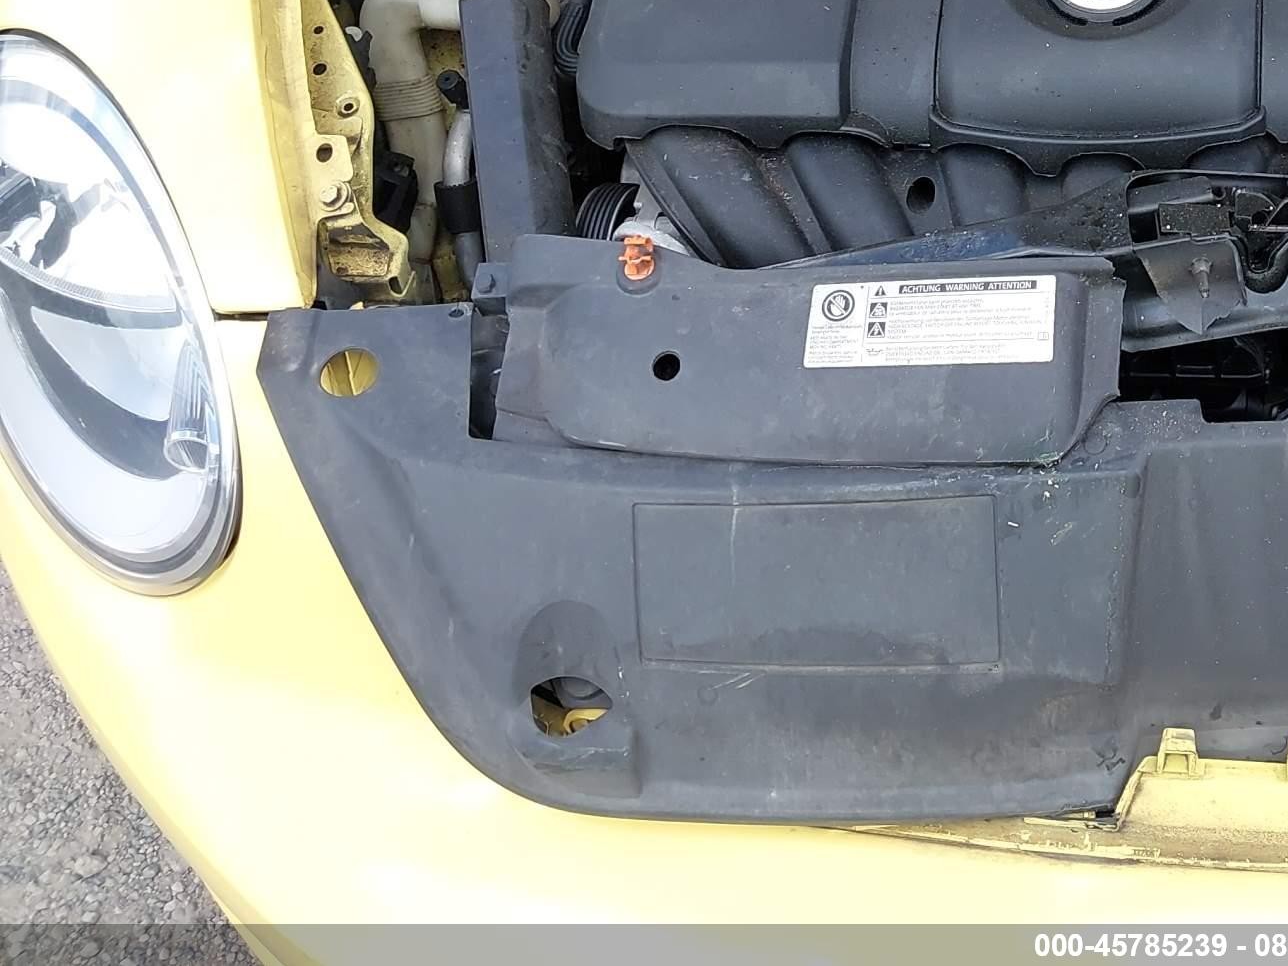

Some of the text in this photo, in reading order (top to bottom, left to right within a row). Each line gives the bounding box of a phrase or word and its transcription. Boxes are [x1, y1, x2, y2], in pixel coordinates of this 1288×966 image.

[902, 281, 1032, 294] ACHTUNG WARNING ATTENTION
